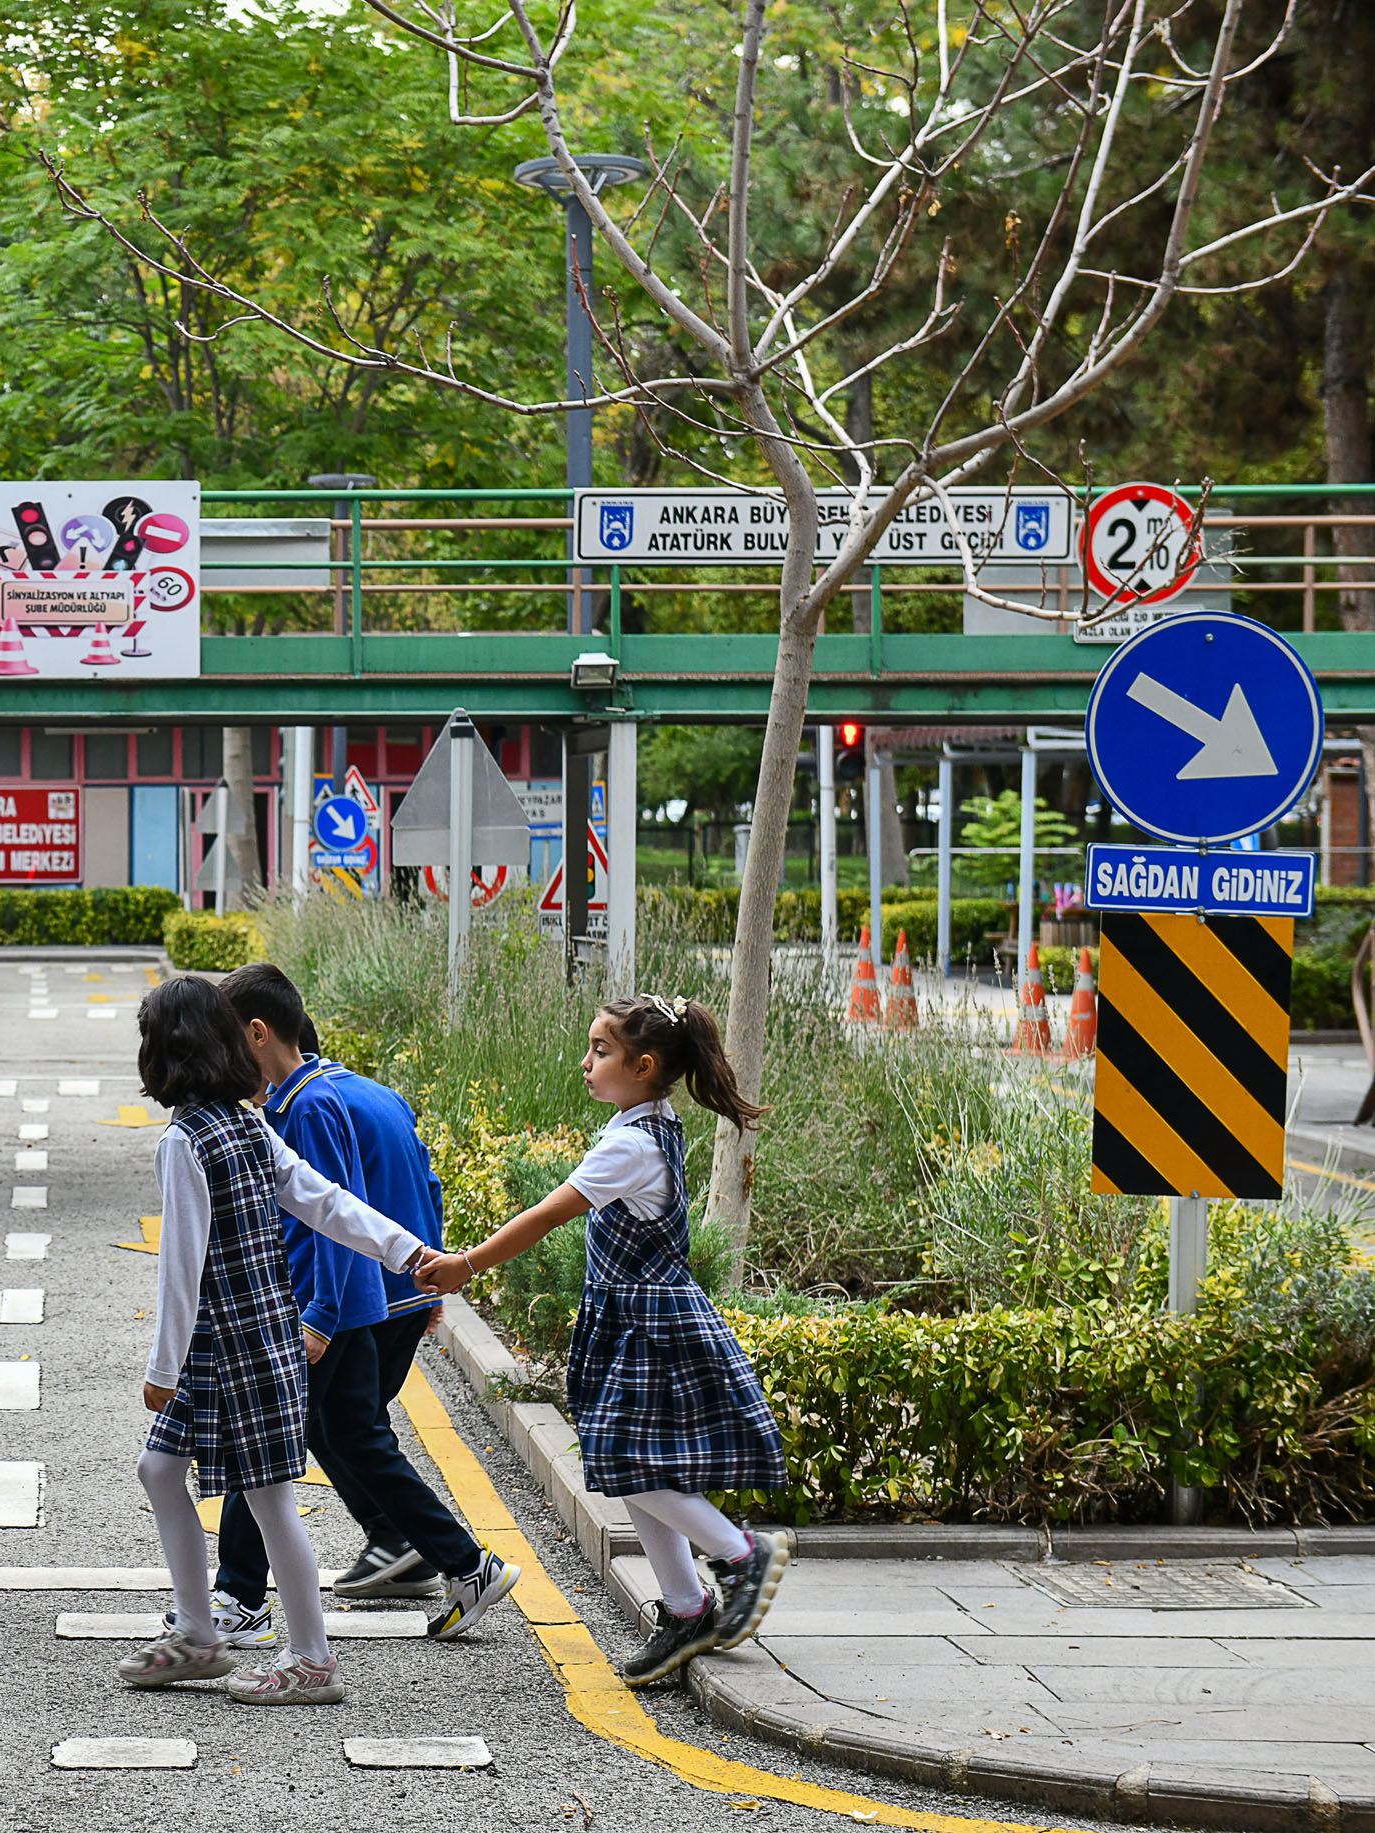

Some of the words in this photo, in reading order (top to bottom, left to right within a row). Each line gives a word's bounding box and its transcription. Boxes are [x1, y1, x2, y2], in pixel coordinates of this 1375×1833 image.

[659, 506, 739, 524] ANKARA
[648, 528, 733, 551] ATATÜRK
[889, 528, 927, 550] ÜST
[1107, 518, 1136, 570] 2
[7, 589, 72, 600] SİNYALİZASYON
[77, 592, 87, 600] VE
[90, 592, 125, 600] ALTYAPI
[158, 577, 182, 595] 60
[25, 604, 48, 613] ŞUBE
[50, 602, 107, 613] MÜDÜRLÜĞÜ
[1096, 855, 1200, 899] SAĞDAN
